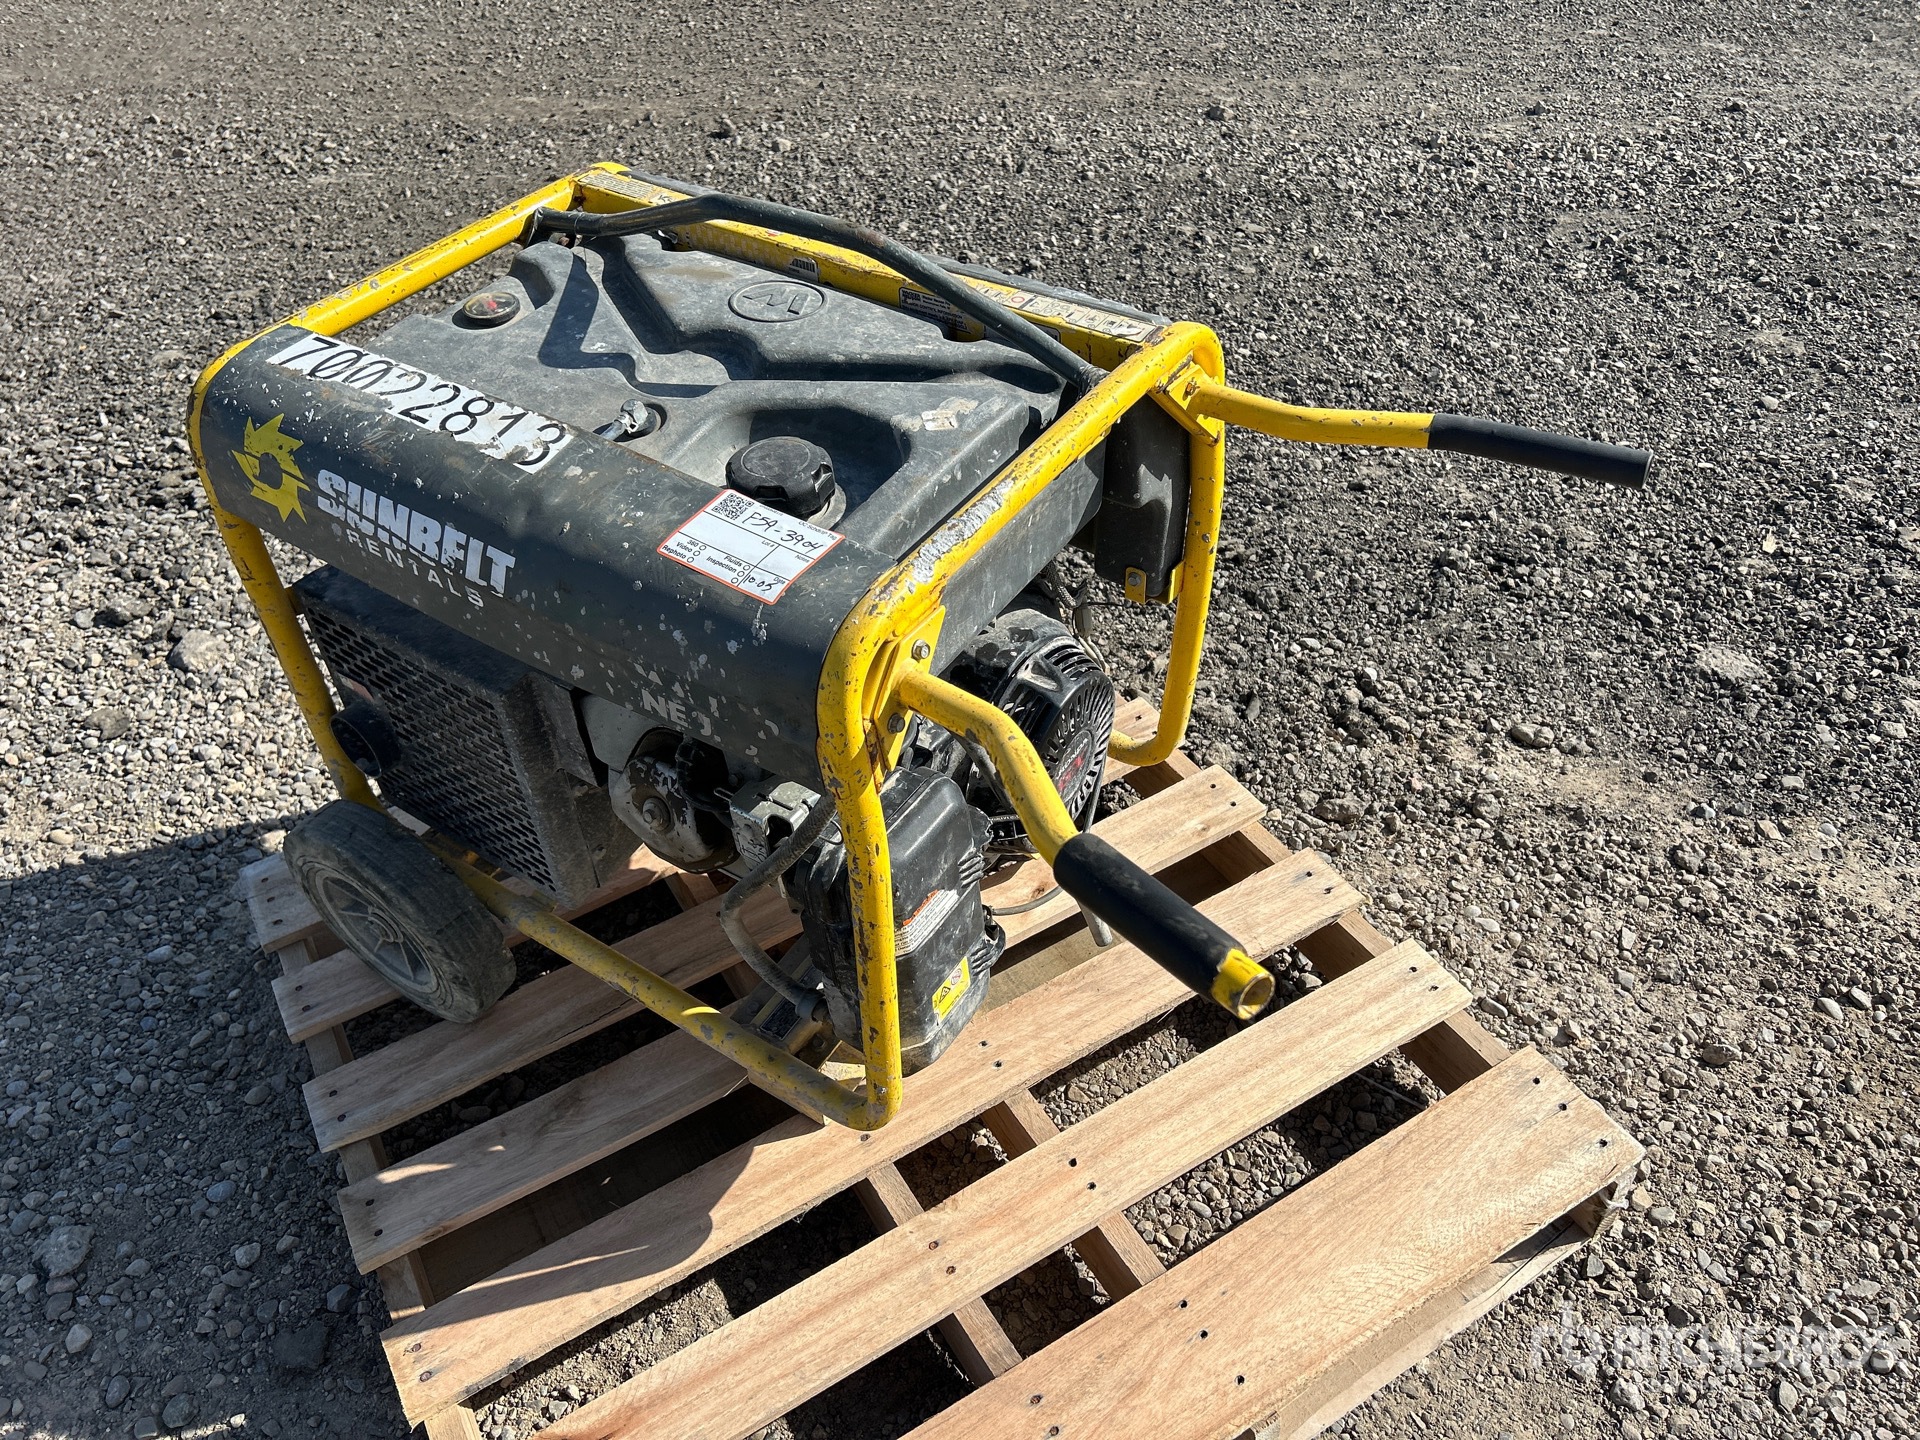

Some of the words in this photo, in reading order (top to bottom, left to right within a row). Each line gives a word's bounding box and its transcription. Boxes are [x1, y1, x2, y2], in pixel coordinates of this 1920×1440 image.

[278, 335, 567, 467] 70022813
[316, 468, 516, 598] SUNBELT
[661, 544, 687, 560] Rephoto
[676, 541, 693, 553] Video
[686, 539, 699, 548] 360
[346, 528, 485, 608] RENTALS
[705, 555, 737, 574] Inspection
[723, 555, 743, 567] Fluids
